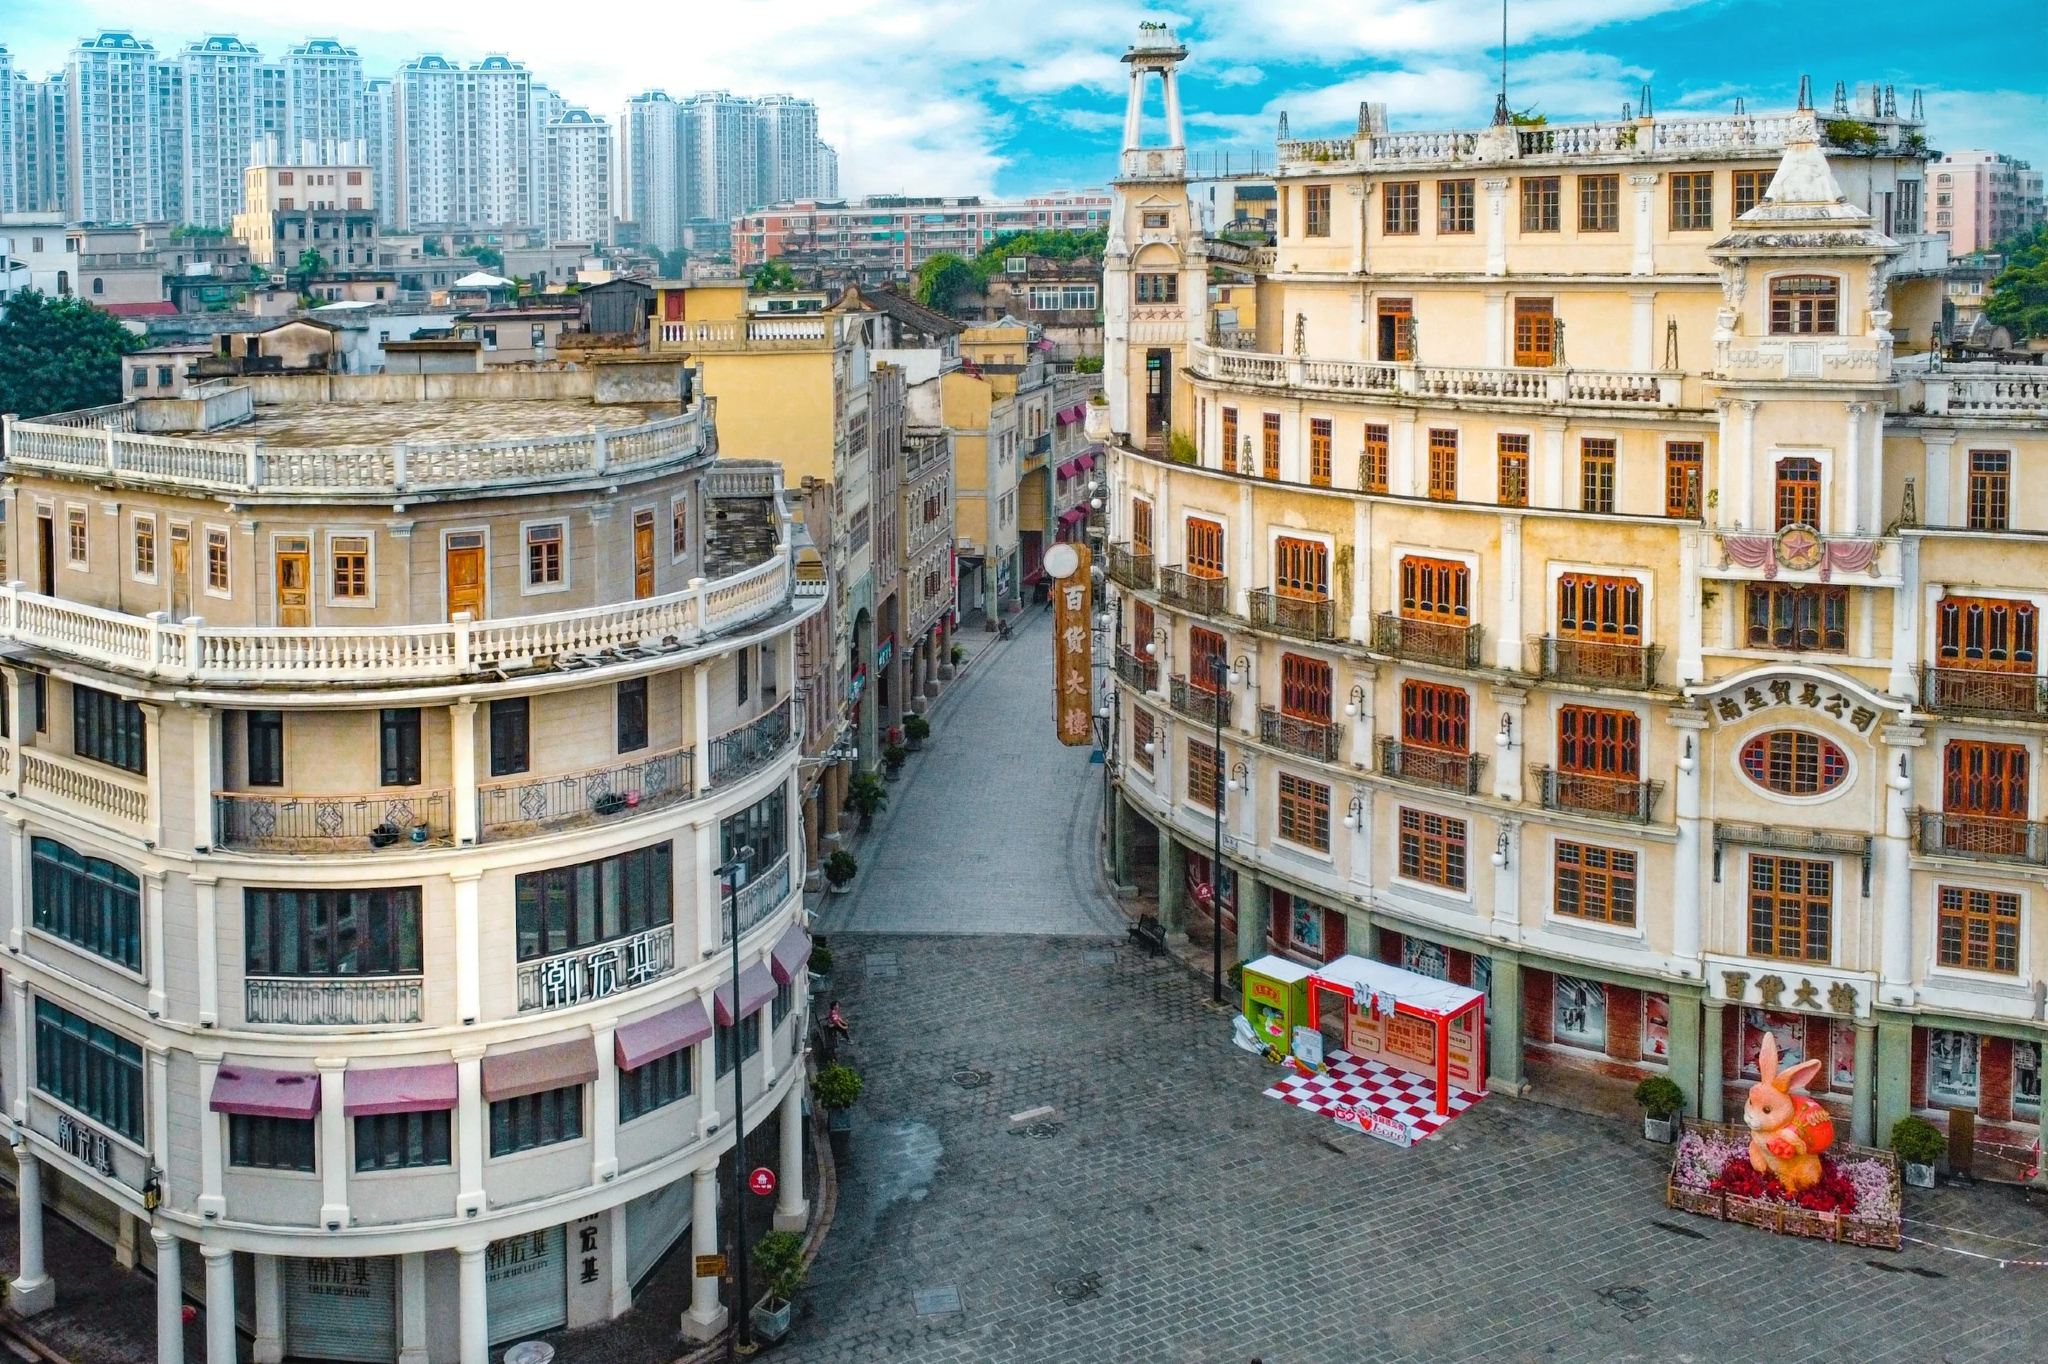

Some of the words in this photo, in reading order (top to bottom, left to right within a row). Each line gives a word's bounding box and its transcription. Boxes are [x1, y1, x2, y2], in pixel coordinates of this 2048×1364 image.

[541, 933, 658, 1010] 潮宏基
[59, 1114, 113, 1177] 潮宏基
